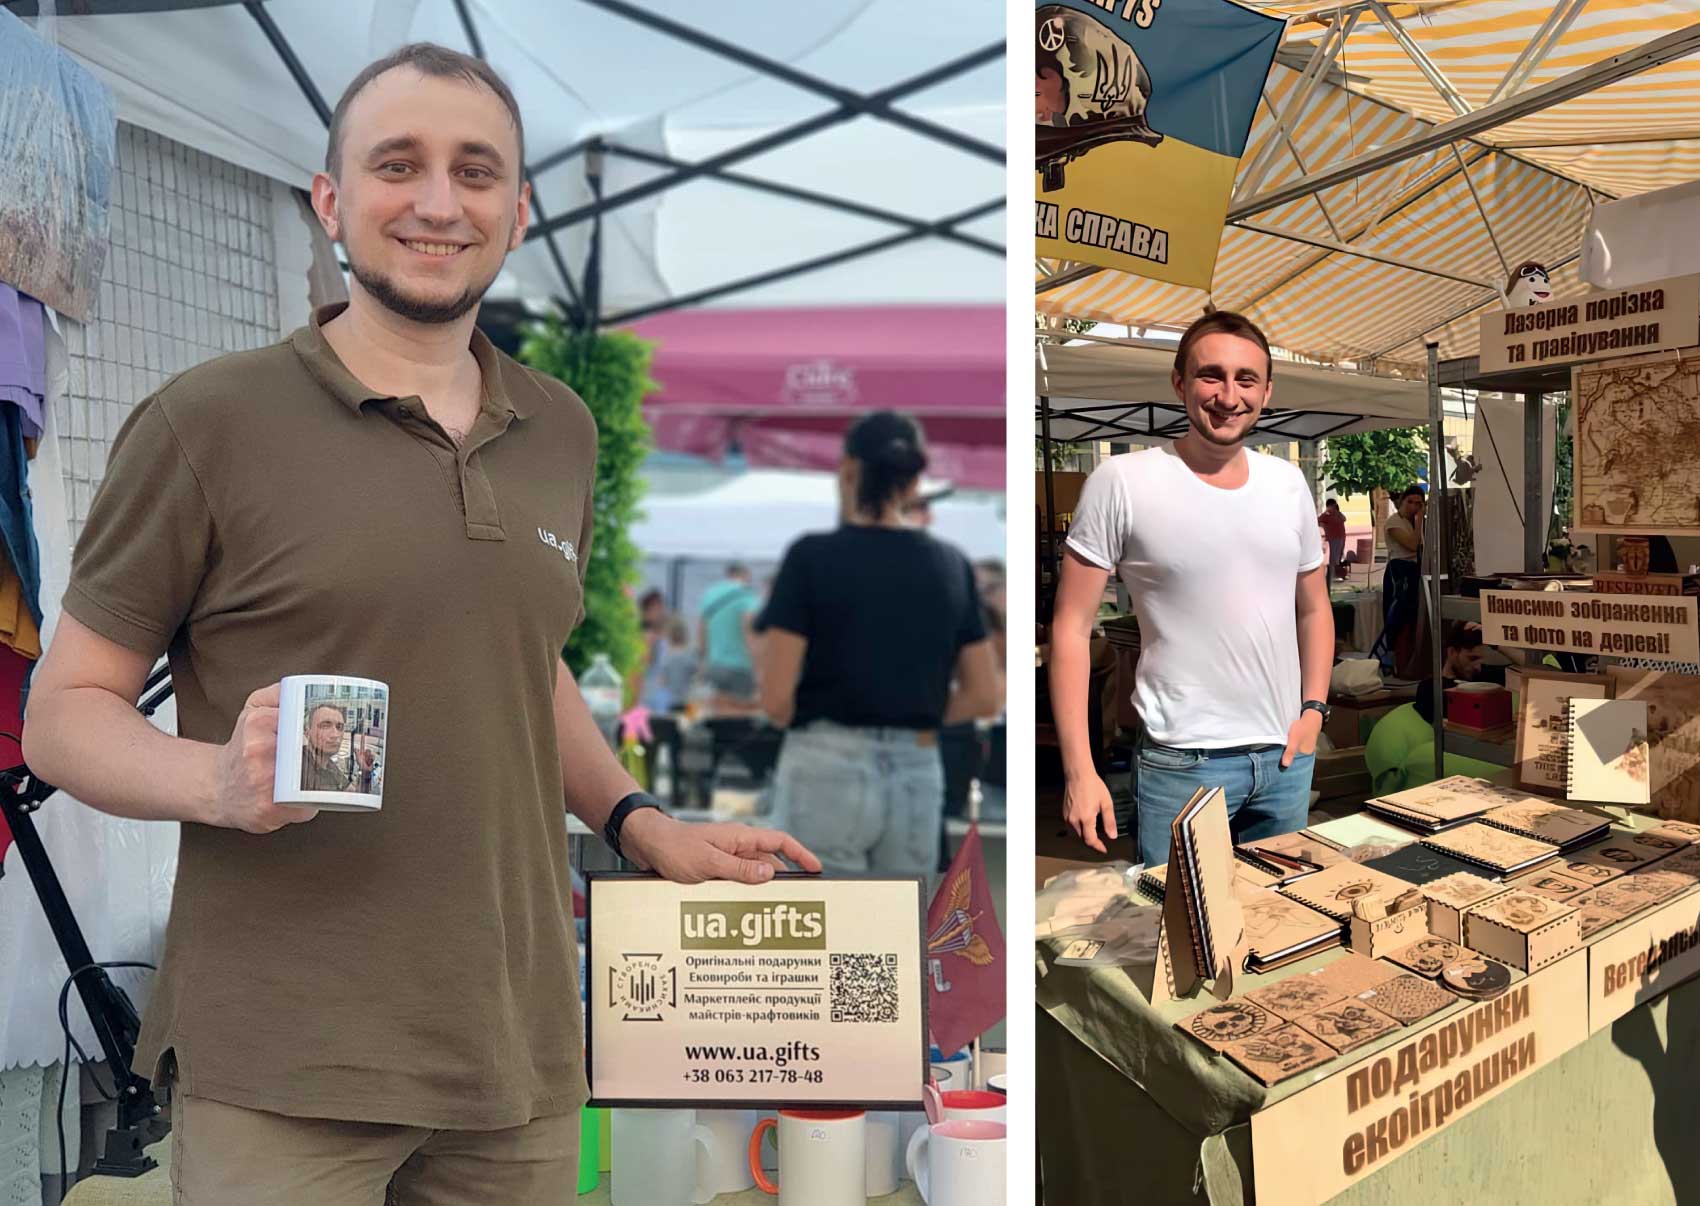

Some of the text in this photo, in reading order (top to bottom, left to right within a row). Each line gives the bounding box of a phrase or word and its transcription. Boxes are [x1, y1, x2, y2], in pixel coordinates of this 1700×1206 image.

[1065, 207, 1168, 265] СПРАВА
[1504, 288, 1664, 335] Лазерна порізка
[1506, 322, 1660, 363] та гравірування
[1488, 594, 1688, 625] Наносимо зображення
[1502, 624, 1670, 654] та фото на дереві!
[683, 904, 823, 946] ua.gifts
[685, 955, 822, 970] Оригінальні подарунки
[689, 971, 818, 986] Ековироби та іграшки
[683, 993, 822, 1008] Маркетплейс продукції
[689, 1008, 820, 1024] майстрів-крафтовиків
[685, 1041, 820, 1067] www.ua.gifts
[1346, 984, 1530, 1116] подарунки
[683, 1069, 823, 1083] +38 063 217-78-48
[1342, 1031, 1536, 1176] екоіграшки
